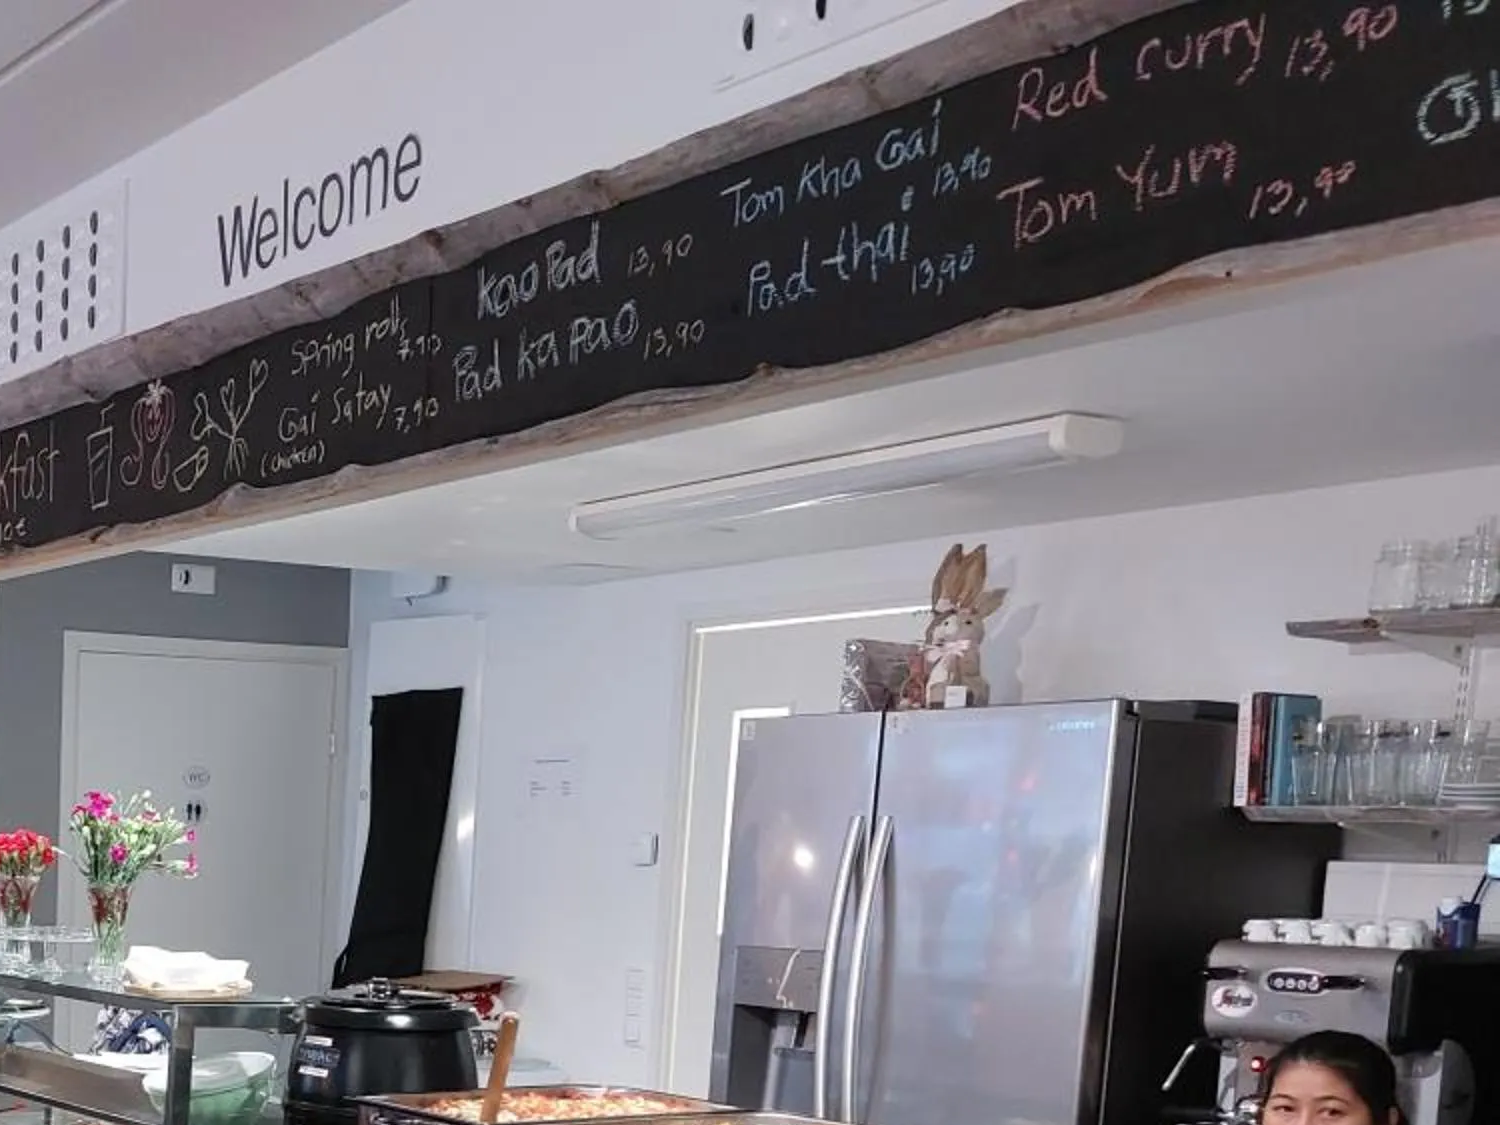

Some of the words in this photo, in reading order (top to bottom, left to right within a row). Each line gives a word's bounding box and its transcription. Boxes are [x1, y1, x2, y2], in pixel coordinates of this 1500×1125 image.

[1011, 47, 1108, 132] Red
[1284, 4, 1397, 82] 13,90
[218, 132, 423, 287] Welcome
[720, 177, 784, 228] Tom
[797, 154, 863, 201] Kha
[875, 98, 942, 172] Gai
[996, 176, 1099, 249] Tom
[1114, 140, 1237, 212] Yum
[546, 219, 602, 290] Pad
[747, 236, 818, 318] Pad
[278, 389, 321, 442] Gai
[331, 371, 392, 430] Satay
[453, 337, 503, 402] Pad
